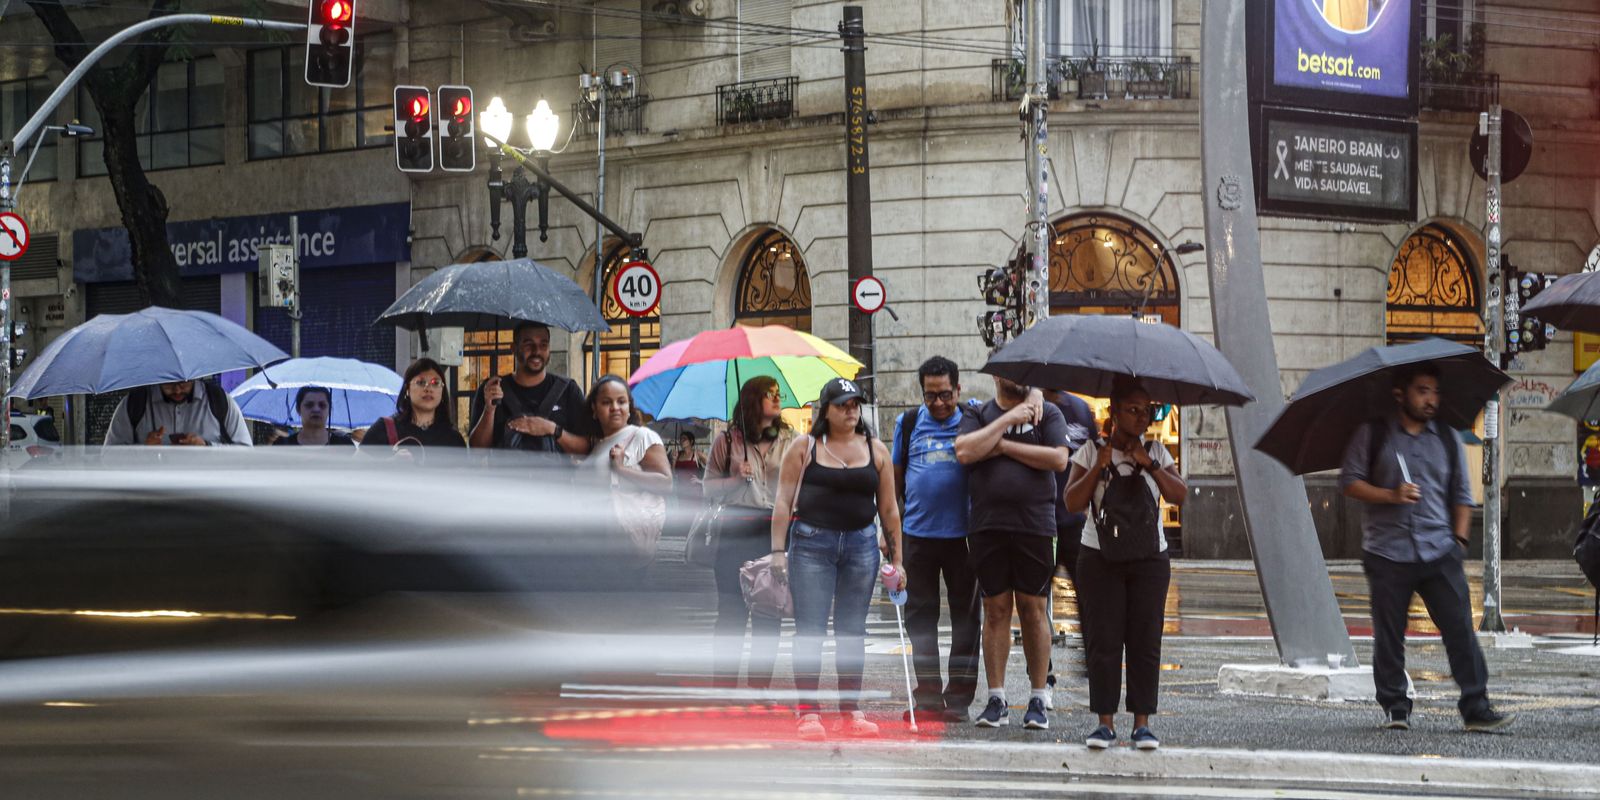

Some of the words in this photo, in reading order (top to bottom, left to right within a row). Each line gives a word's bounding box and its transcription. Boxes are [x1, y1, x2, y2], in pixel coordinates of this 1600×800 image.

[1297, 47, 1380, 80] betsat.com
[851, 86, 865, 174] 5765872-3
[1294, 136, 1346, 154] JANEIRO
[1349, 141, 1400, 159] BRANCO
[1330, 161, 1383, 180] SAUDÁVEL,
[1294, 177, 1319, 191] VIDA
[1320, 179, 1372, 195] SAUDÁVEL
[621, 274, 652, 298] 40
